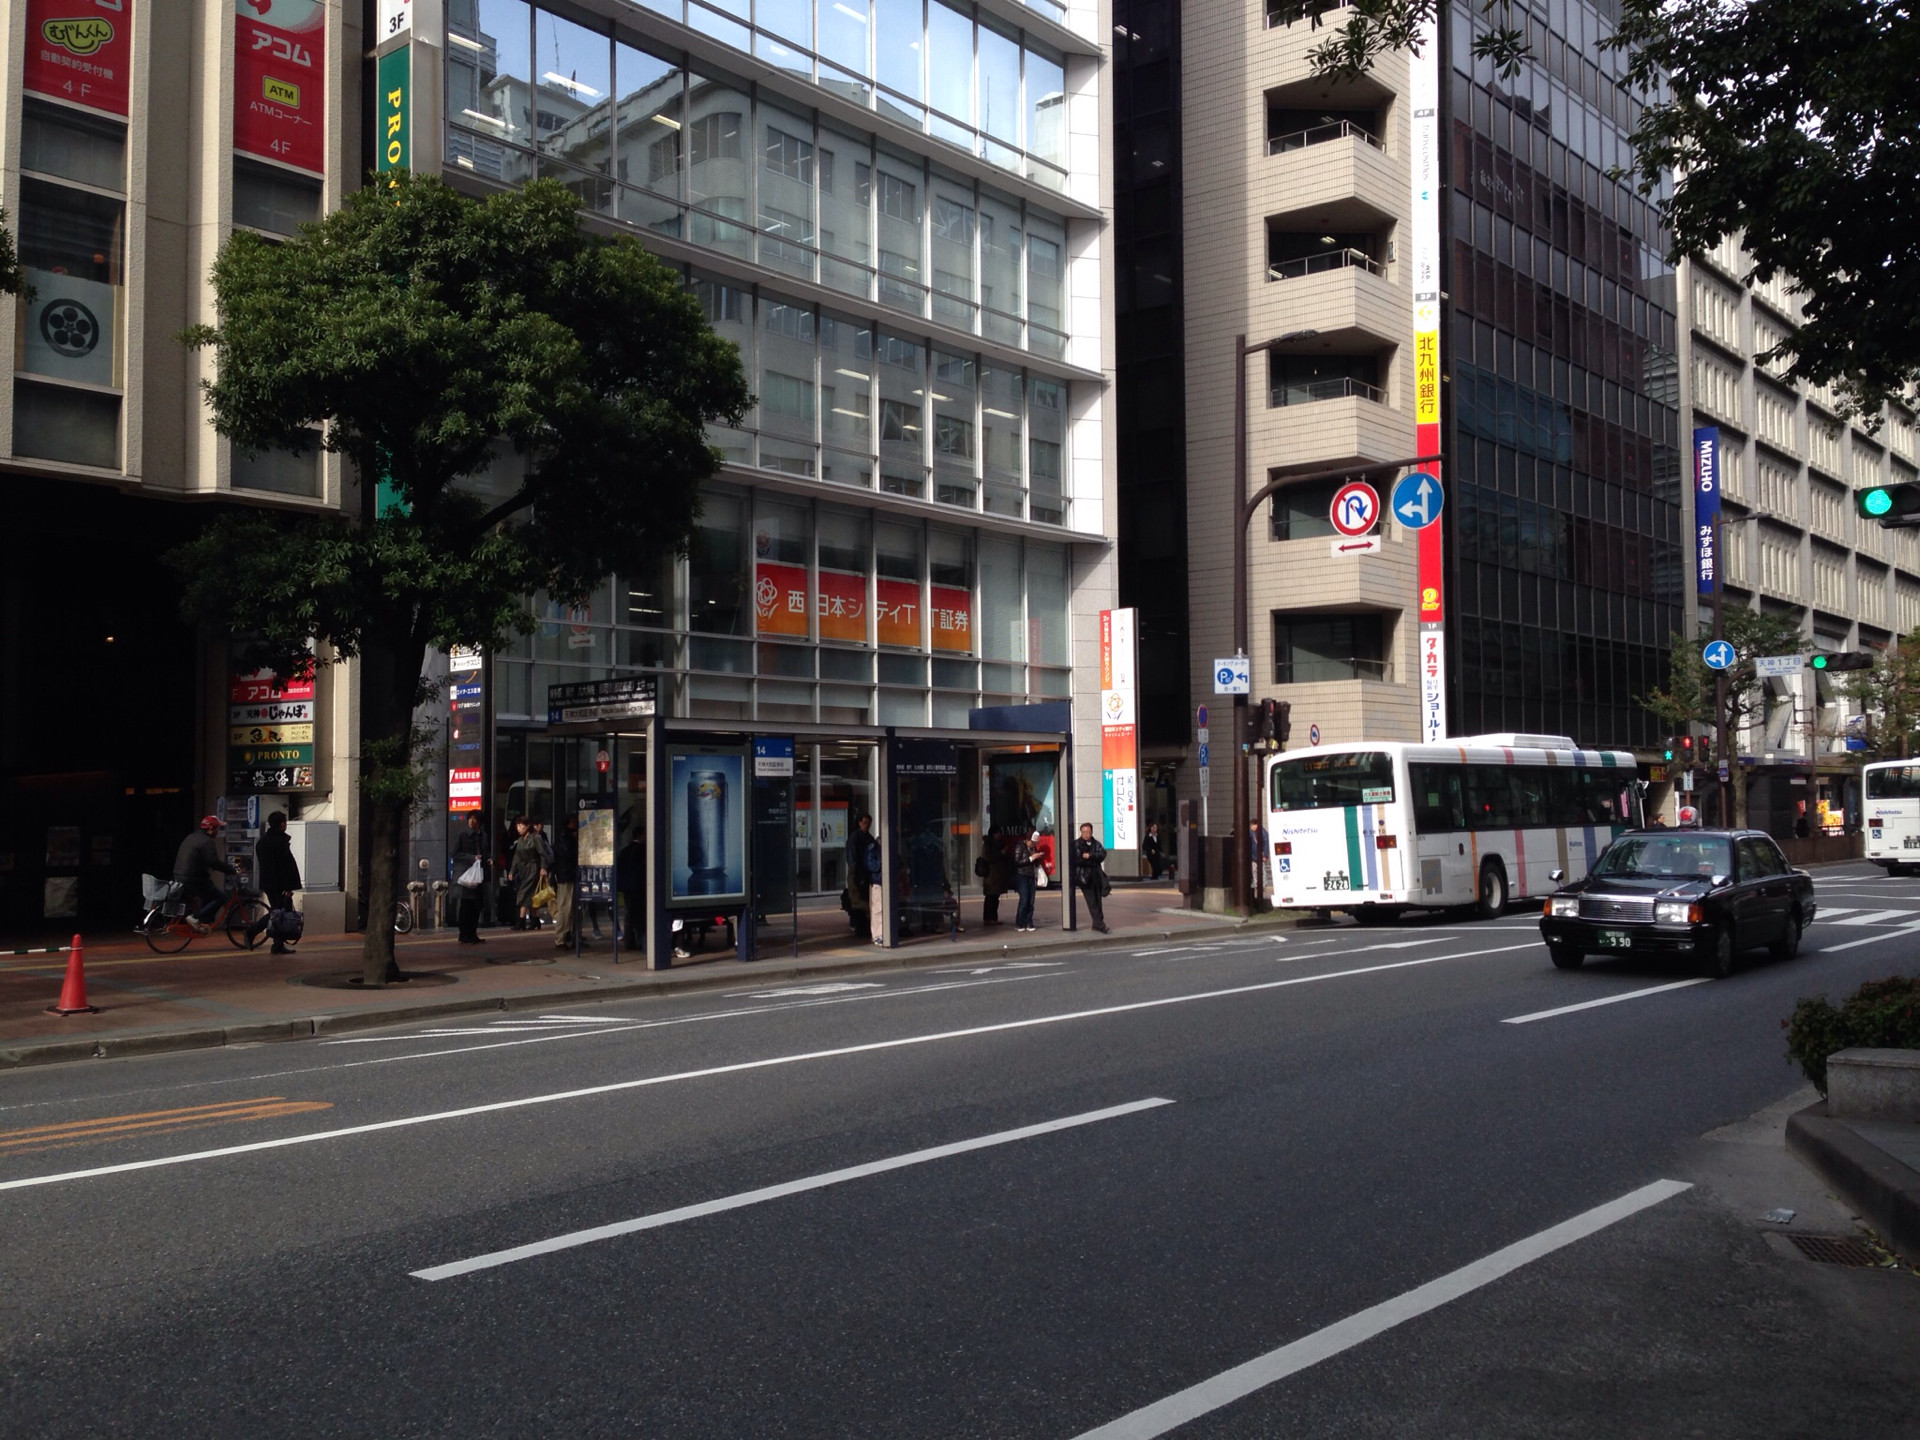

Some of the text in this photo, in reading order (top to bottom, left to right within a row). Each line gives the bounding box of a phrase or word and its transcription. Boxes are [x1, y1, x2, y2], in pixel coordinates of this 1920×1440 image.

[389, 11, 404, 33] 3F
[49, 23, 109, 49] むじんくん
[251, 28, 311, 67] アコム
[40, 50, 114, 80] 自動契約受付機
[269, 84, 294, 100] ATM
[250, 100, 312, 125] ATMコーナー
[1418, 336, 1435, 414] 北九州銀行
[1700, 440, 1713, 492] MIZUHO
[1700, 525, 1713, 580] みずほ銀行
[1426, 637, 1438, 678] タカラ
[1758, 657, 1801, 667] 天神1丁目
[248, 685, 281, 700] アコム
[269, 704, 307, 720] じゃんぼ
[257, 749, 300, 760] PRONTO
[756, 745, 766, 755] 14
[1116, 776, 1126, 840] セコムショップ
